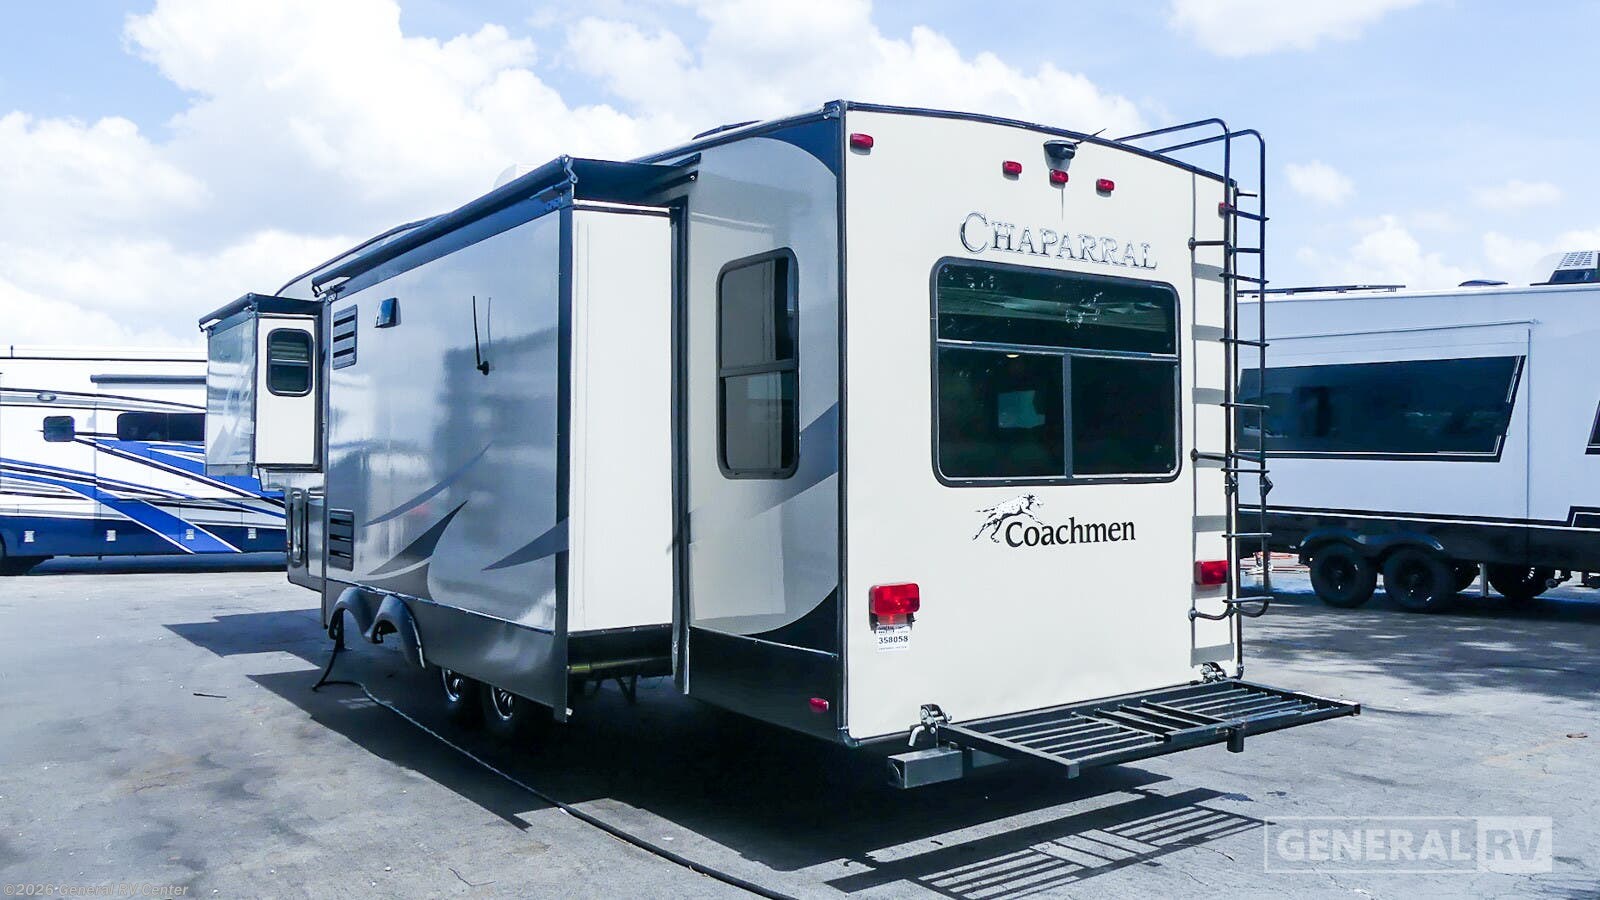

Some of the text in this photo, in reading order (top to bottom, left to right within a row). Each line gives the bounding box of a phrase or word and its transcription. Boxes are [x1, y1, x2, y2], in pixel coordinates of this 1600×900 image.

[960, 212, 1158, 270] CHAPARRAL
[1005, 516, 1136, 548] Coachmen
[878, 635, 909, 645] 358058
